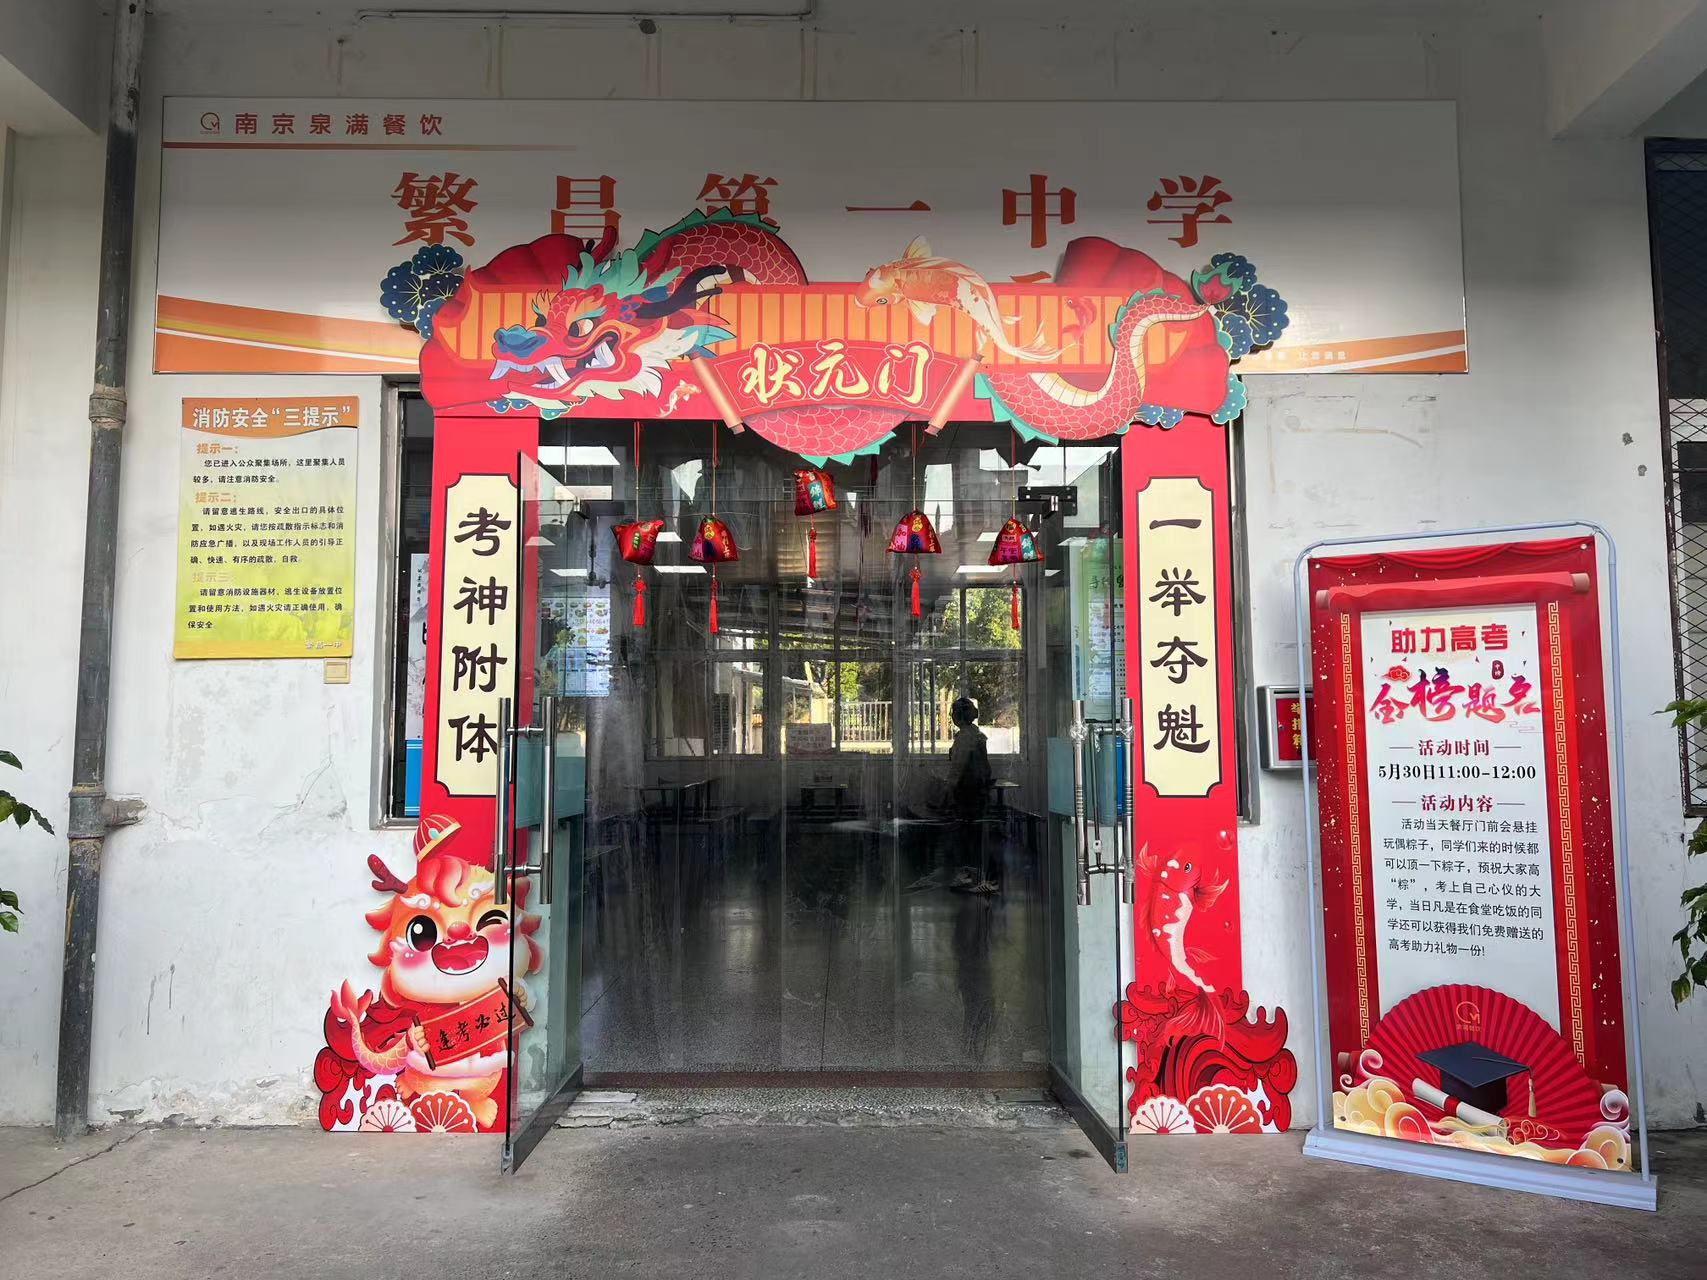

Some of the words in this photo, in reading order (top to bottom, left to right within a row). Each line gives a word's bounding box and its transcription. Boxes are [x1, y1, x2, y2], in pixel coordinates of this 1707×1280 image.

[235, 112, 443, 136] 南京泉满餐饮
[741, 341, 930, 405] 状元门
[192, 405, 351, 429] 消防安全“三提示”
[448, 506, 513, 764] 考神附体
[1149, 518, 1211, 754] 一举夺魁
[1391, 623, 1509, 654] 助力高考
[1369, 666, 1541, 724] 金榜题名
[1418, 738, 1490, 757] 活动时间
[1420, 793, 1494, 813] 活动内容
[1400, 817, 1538, 834] 活动当天餐厅门前会悬挂
[1383, 837, 1540, 855] 玩偶粽子，同学们来的时候都
[1384, 857, 1541, 877] 可以顶一下粽子，预祝大家高
[1386, 897, 1543, 920] 学，当日凡是在食堂吃饭的同
[1387, 918, 1544, 941] 学还可以获得我们免费赠送的
[435, 1001, 517, 1053] 逢考必过
